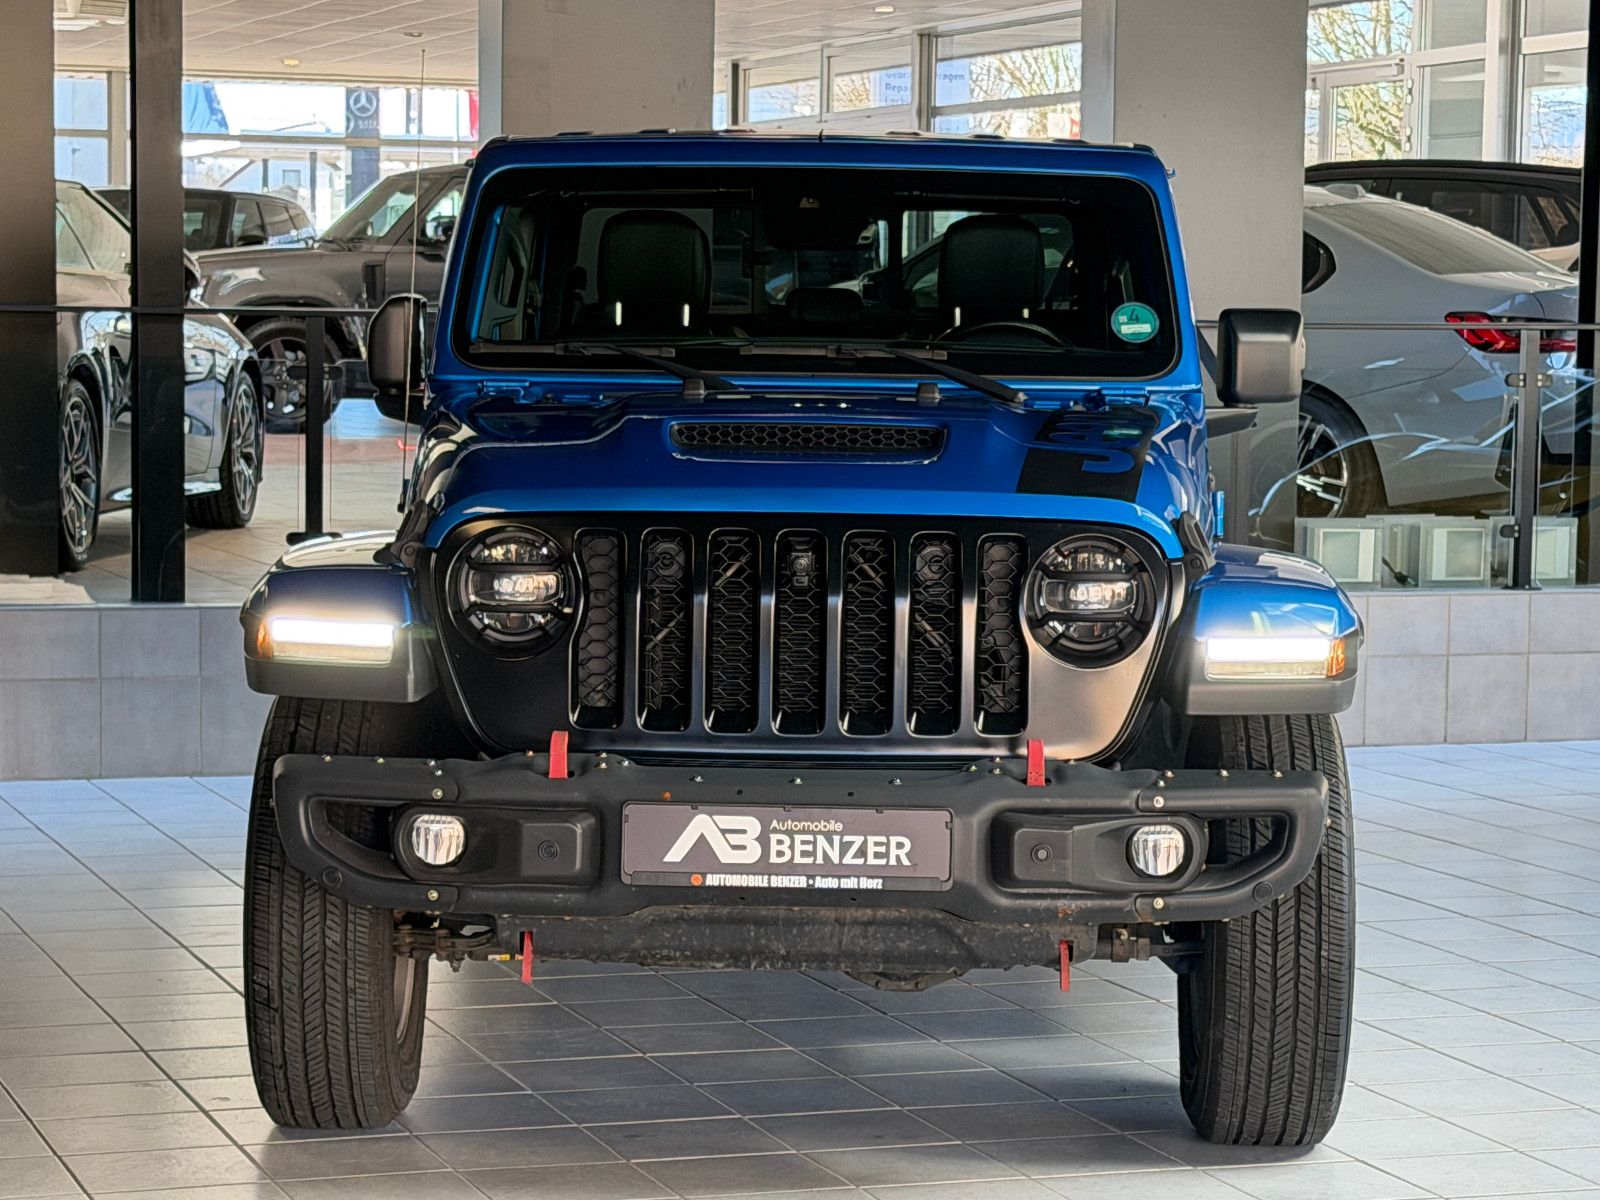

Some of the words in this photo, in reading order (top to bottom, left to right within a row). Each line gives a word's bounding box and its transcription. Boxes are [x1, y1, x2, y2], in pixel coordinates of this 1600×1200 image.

[769, 818, 844, 832] Automobile
[768, 833, 912, 866] BENZER
[705, 873, 769, 887] AUTOMOBILE
[770, 875, 807, 888] BENZER
[814, 876, 839, 888] Auto
[840, 877, 858, 889] mit
[859, 877, 883, 890] Herz
